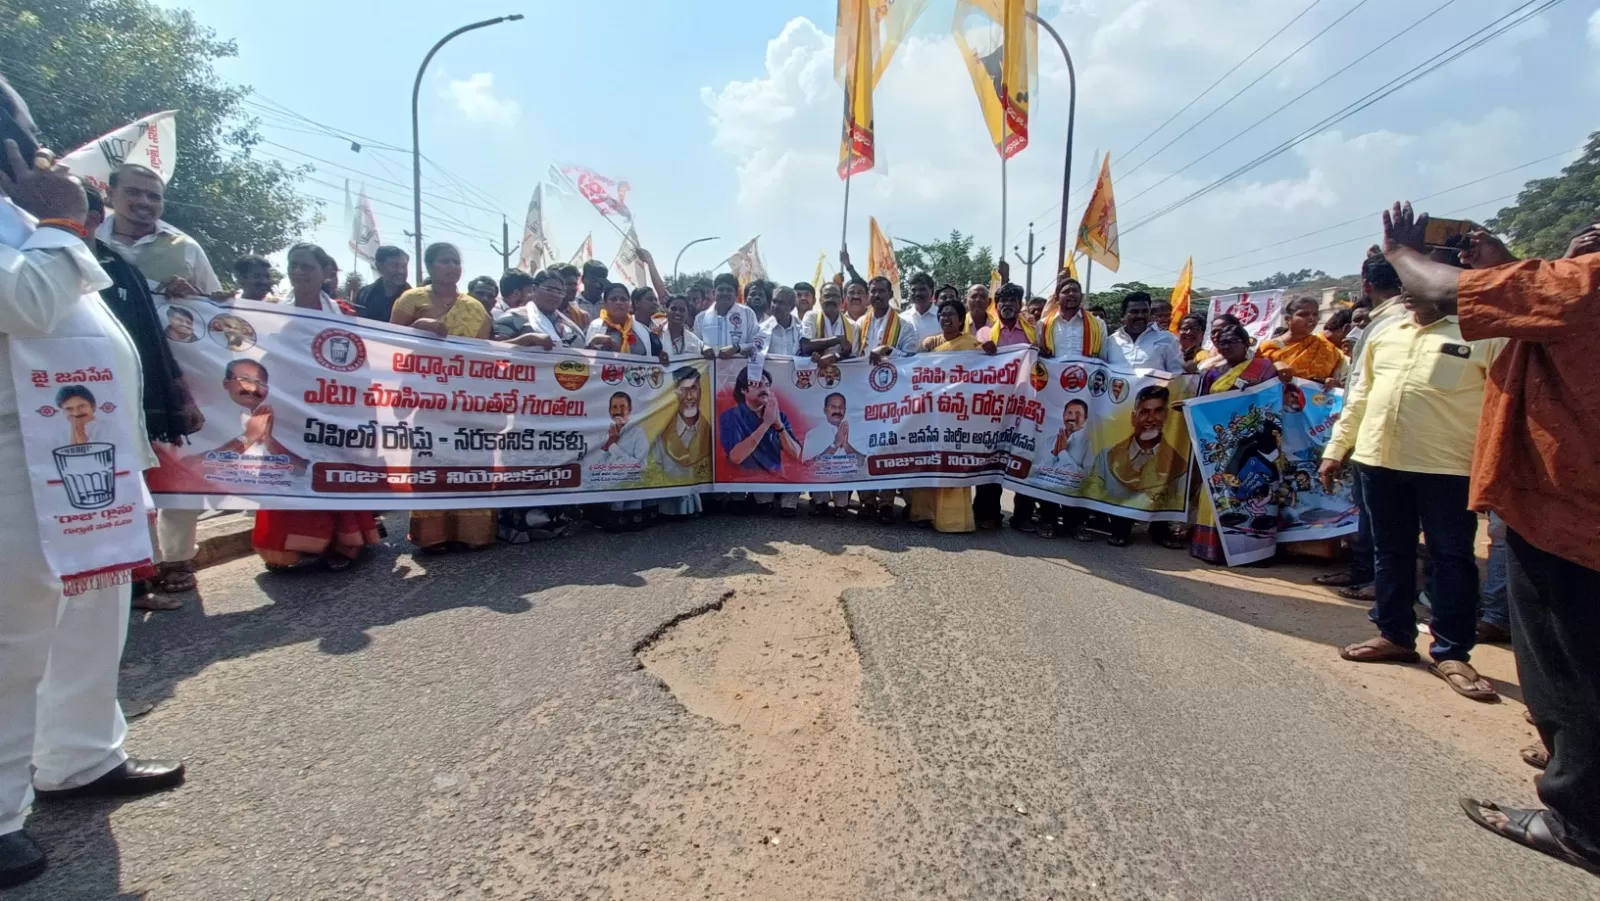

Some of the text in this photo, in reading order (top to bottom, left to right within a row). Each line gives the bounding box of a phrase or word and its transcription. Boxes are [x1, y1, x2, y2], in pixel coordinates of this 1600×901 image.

[31, 366, 114, 388] జై జనసేన
[392, 352, 536, 383] అధ్వాన దారులు
[911, 366, 946, 391] వైసిపి
[949, 358, 1021, 385] పాలనలో
[304, 377, 357, 406] ఎటు
[363, 382, 447, 411] చూసినా
[451, 387, 519, 415] గుంతలే
[937, 391, 969, 421] ఉన్న
[303, 417, 378, 449] ఏపిలో
[381, 420, 434, 458] రోడ్లు
[453, 426, 535, 451] నరకానికి
[908, 424, 939, 444] జనసేన
[943, 427, 971, 450] పార్టీల
[324, 467, 437, 486] గాజువాక
[875, 454, 942, 469] గాజువాక
